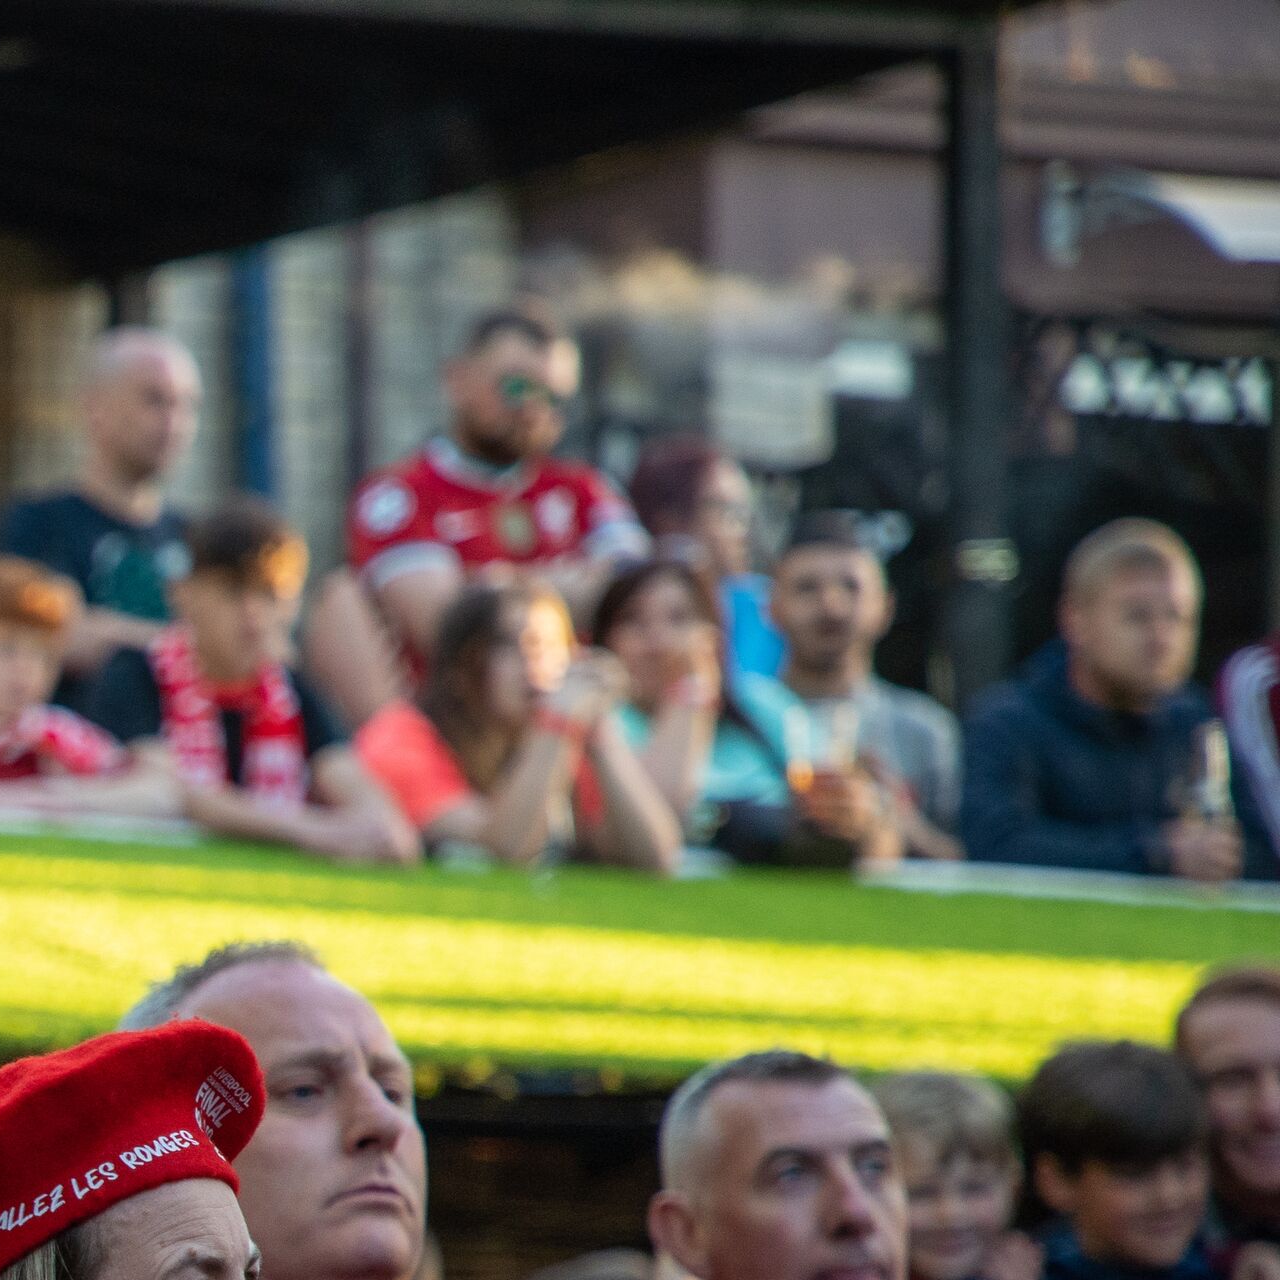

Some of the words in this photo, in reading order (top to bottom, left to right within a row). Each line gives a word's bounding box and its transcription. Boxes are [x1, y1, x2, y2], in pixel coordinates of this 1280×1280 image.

[195, 1081, 232, 1129] FINAL
[212, 1064, 252, 1109] LIVERPOOL
[70, 1161, 119, 1201] LES
[119, 1128, 201, 1171] ROUGES
